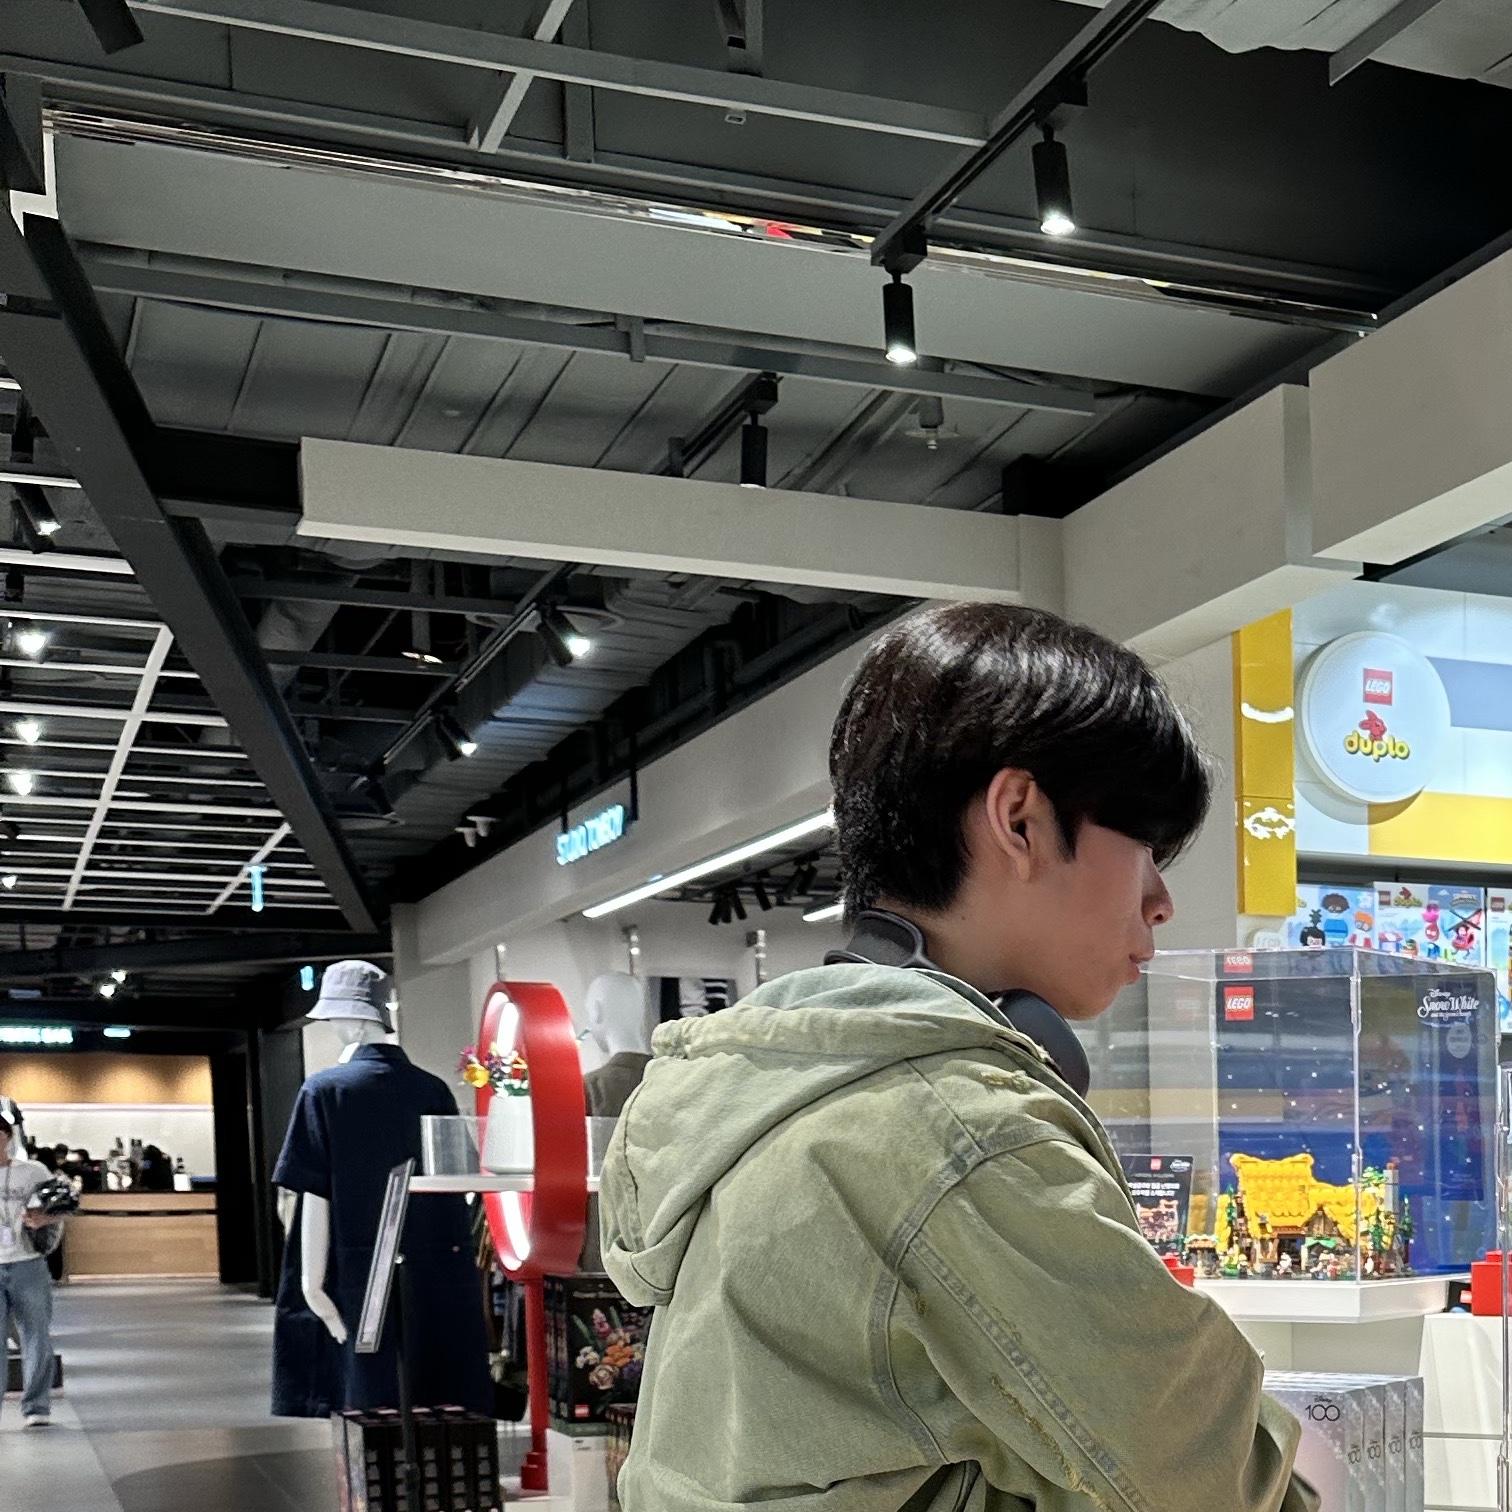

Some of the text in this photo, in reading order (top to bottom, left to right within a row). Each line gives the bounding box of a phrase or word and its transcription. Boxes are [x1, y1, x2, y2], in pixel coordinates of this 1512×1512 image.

[1365, 680, 1391, 694] LEGO
[1343, 730, 1411, 763] duplo
[1226, 997, 1252, 1011] LEGO
[1417, 996, 1450, 1018] Snow
[1449, 995, 1479, 1012] White
[1305, 1404, 1341, 1422] 100
